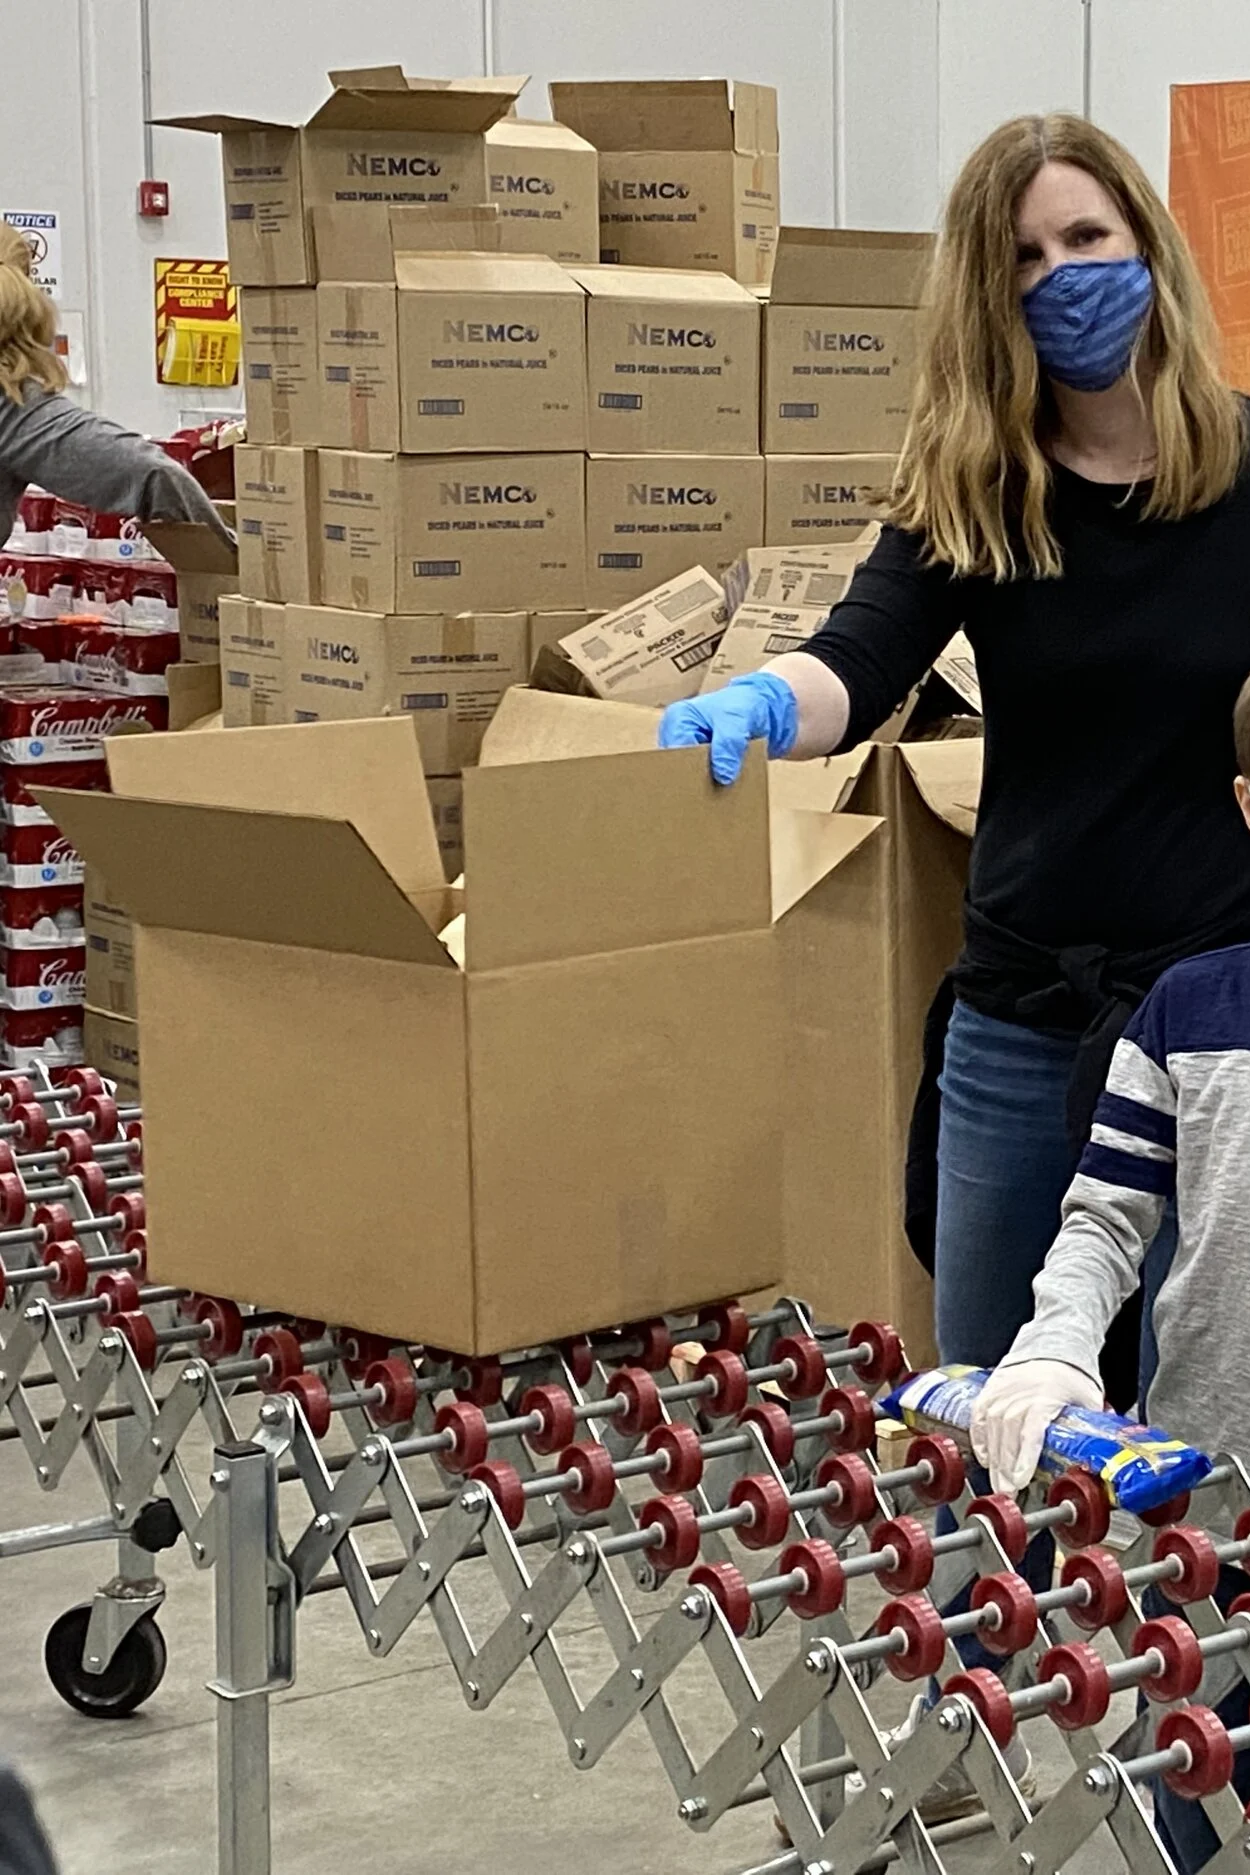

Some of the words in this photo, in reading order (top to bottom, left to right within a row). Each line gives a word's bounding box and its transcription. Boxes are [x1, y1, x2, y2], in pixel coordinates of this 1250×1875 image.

[490, 175, 555, 195] EMCO
[6, 215, 54, 226] NOTICE
[803, 483, 856, 503] NEM
